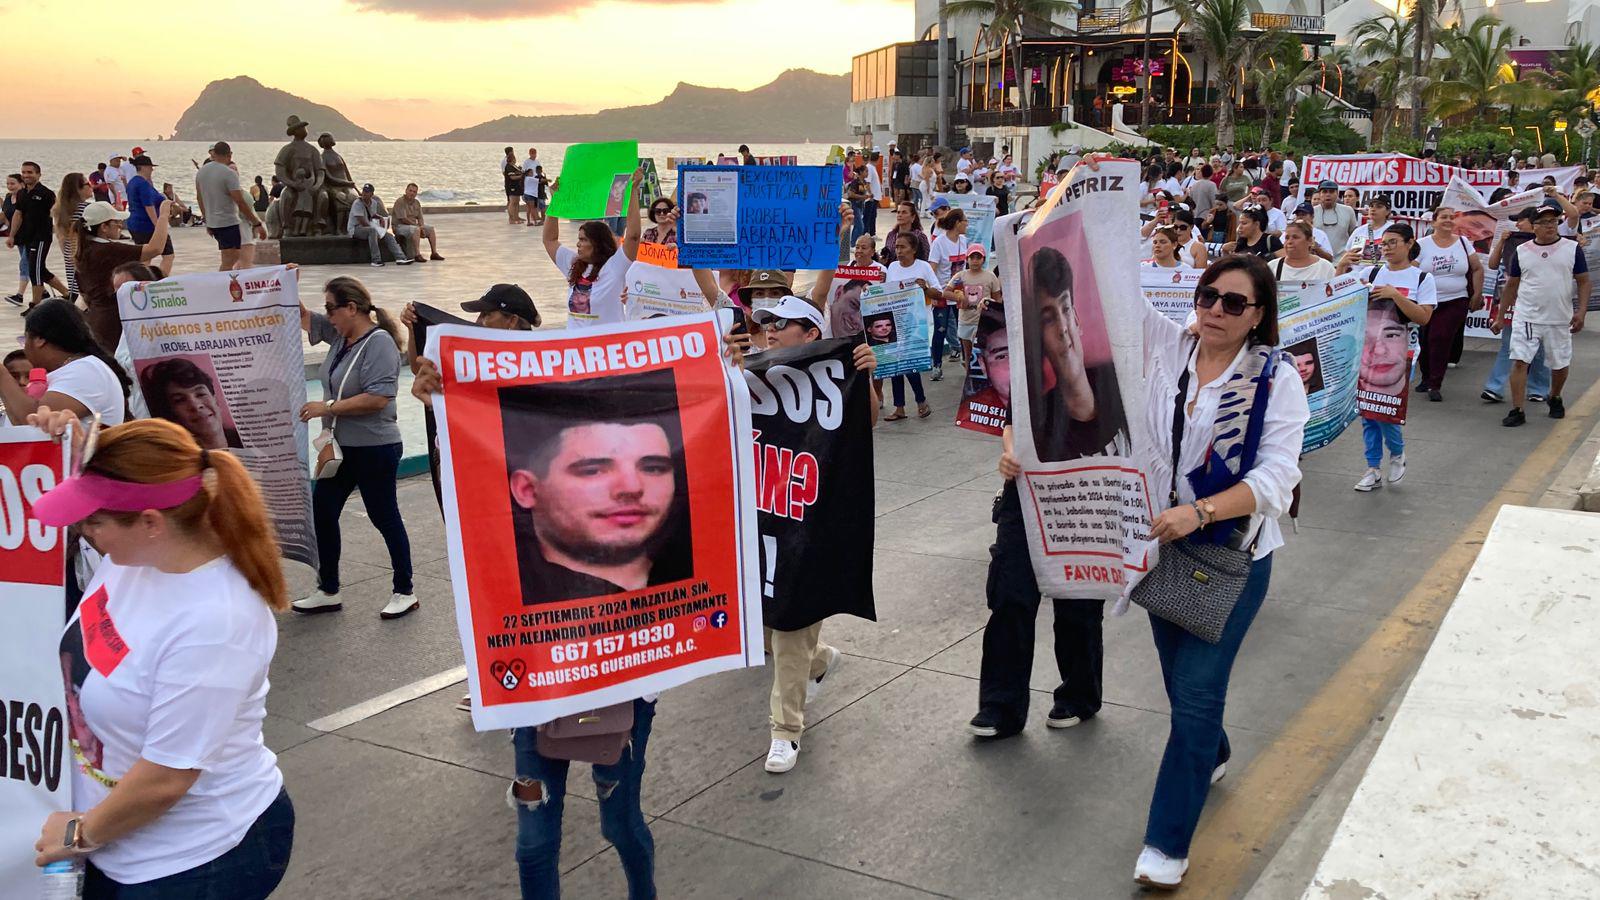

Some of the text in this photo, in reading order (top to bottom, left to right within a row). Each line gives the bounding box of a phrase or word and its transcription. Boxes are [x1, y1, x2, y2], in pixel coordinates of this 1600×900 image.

[1308, 159, 1399, 183] EXIGIMOS
[1065, 176, 1124, 203] PETRIZ
[151, 294, 188, 310] Sinaloa
[140, 321, 202, 343] Ayúdanos
[204, 322, 213, 333] a
[160, 332, 273, 354] IROBEL ABRAJAN PETRIZ
[453, 331, 706, 384] DESAPARECIDO
[969, 401, 988, 413] VIVO
[989, 407, 1000, 416] SE
[970, 413, 989, 425] VIVO
[990, 418, 1000, 428] LO
[1047, 480, 1075, 492] privado
[1079, 478, 1089, 487] de
[1078, 492, 1087, 501] de
[1087, 492, 1104, 501] 2024
[1056, 520, 1076, 529] bordo
[1079, 520, 1088, 529] de
[1064, 565, 1110, 583] FAVOR
[503, 615, 518, 629] 22
[520, 605, 595, 628] SEPTIEMBRE
[597, 601, 627, 618] 2024
[691, 582, 711, 597] SIN.
[487, 594, 728, 649] NERY ALEJANDRO VILLALOBOS BUSTAMANTE
[550, 622, 675, 664] 667 157 1930
[527, 638, 698, 688] SABUESOS GUERRERAS, A.C.
